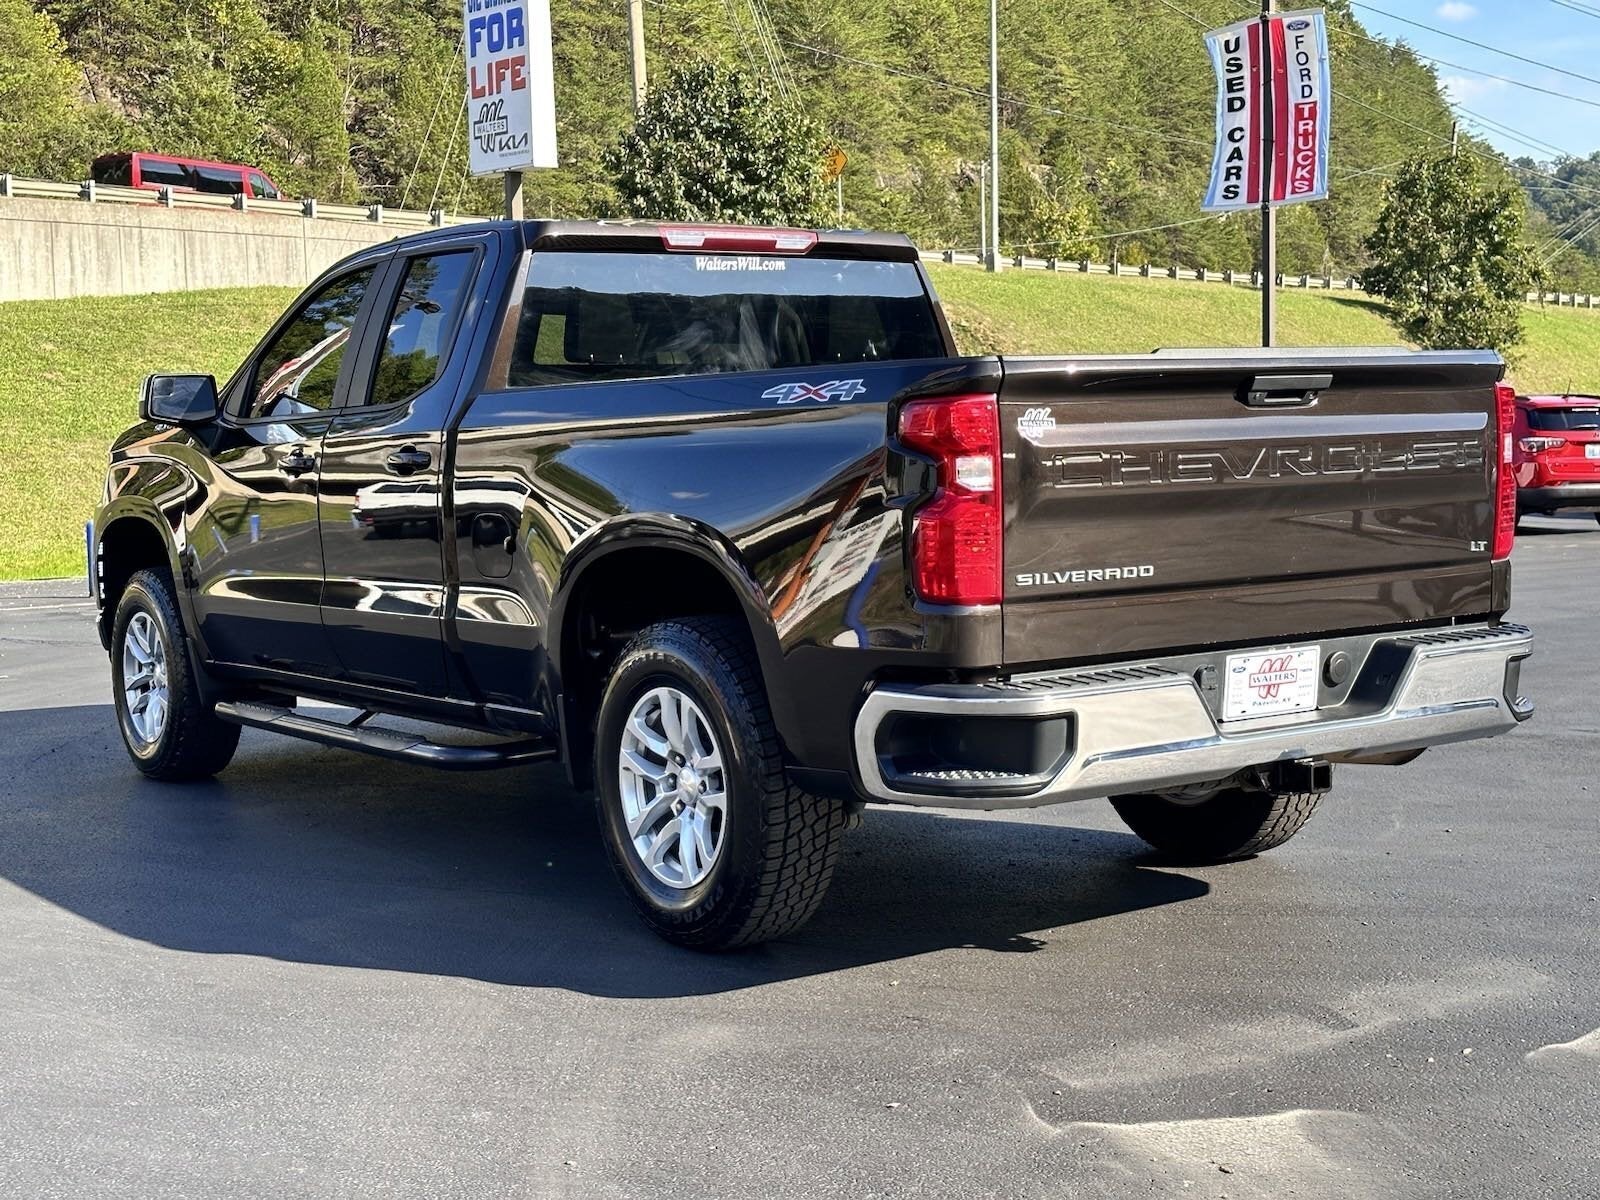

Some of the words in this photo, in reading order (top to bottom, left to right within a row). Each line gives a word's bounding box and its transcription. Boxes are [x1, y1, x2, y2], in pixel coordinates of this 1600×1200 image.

[470, 7, 524, 57] FOR
[471, 55, 526, 99] LIFE
[1224, 36, 1245, 113] USED
[1295, 35, 1313, 98] FORD
[477, 121, 504, 135] WALTERS
[1294, 104, 1315, 193] TRUCKS
[1222, 127, 1244, 199] CARS
[695, 257, 786, 271] WaltersWill.com
[1053, 440, 1483, 488] CHEVROLET
[1471, 541, 1488, 551] LT
[1015, 565, 1155, 586] SILVERADO
[1253, 672, 1295, 684] WALTERS
